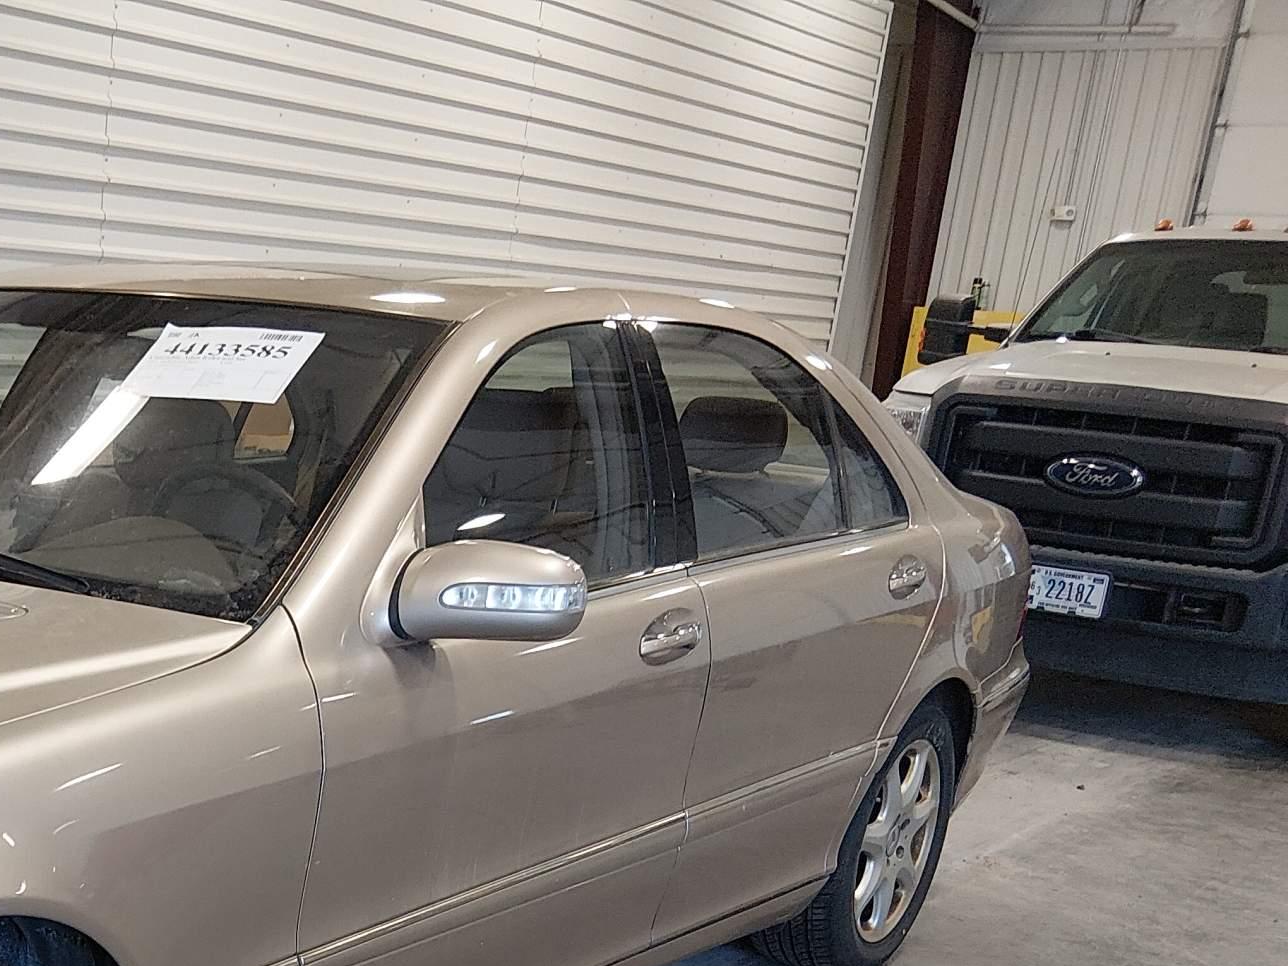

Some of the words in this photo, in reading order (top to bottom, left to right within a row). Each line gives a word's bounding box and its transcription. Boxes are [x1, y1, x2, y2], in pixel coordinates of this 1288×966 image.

[164, 342, 292, 359] 44133585
[1065, 462, 1120, 487] Ford
[1045, 579, 1095, 605] 2218Z
